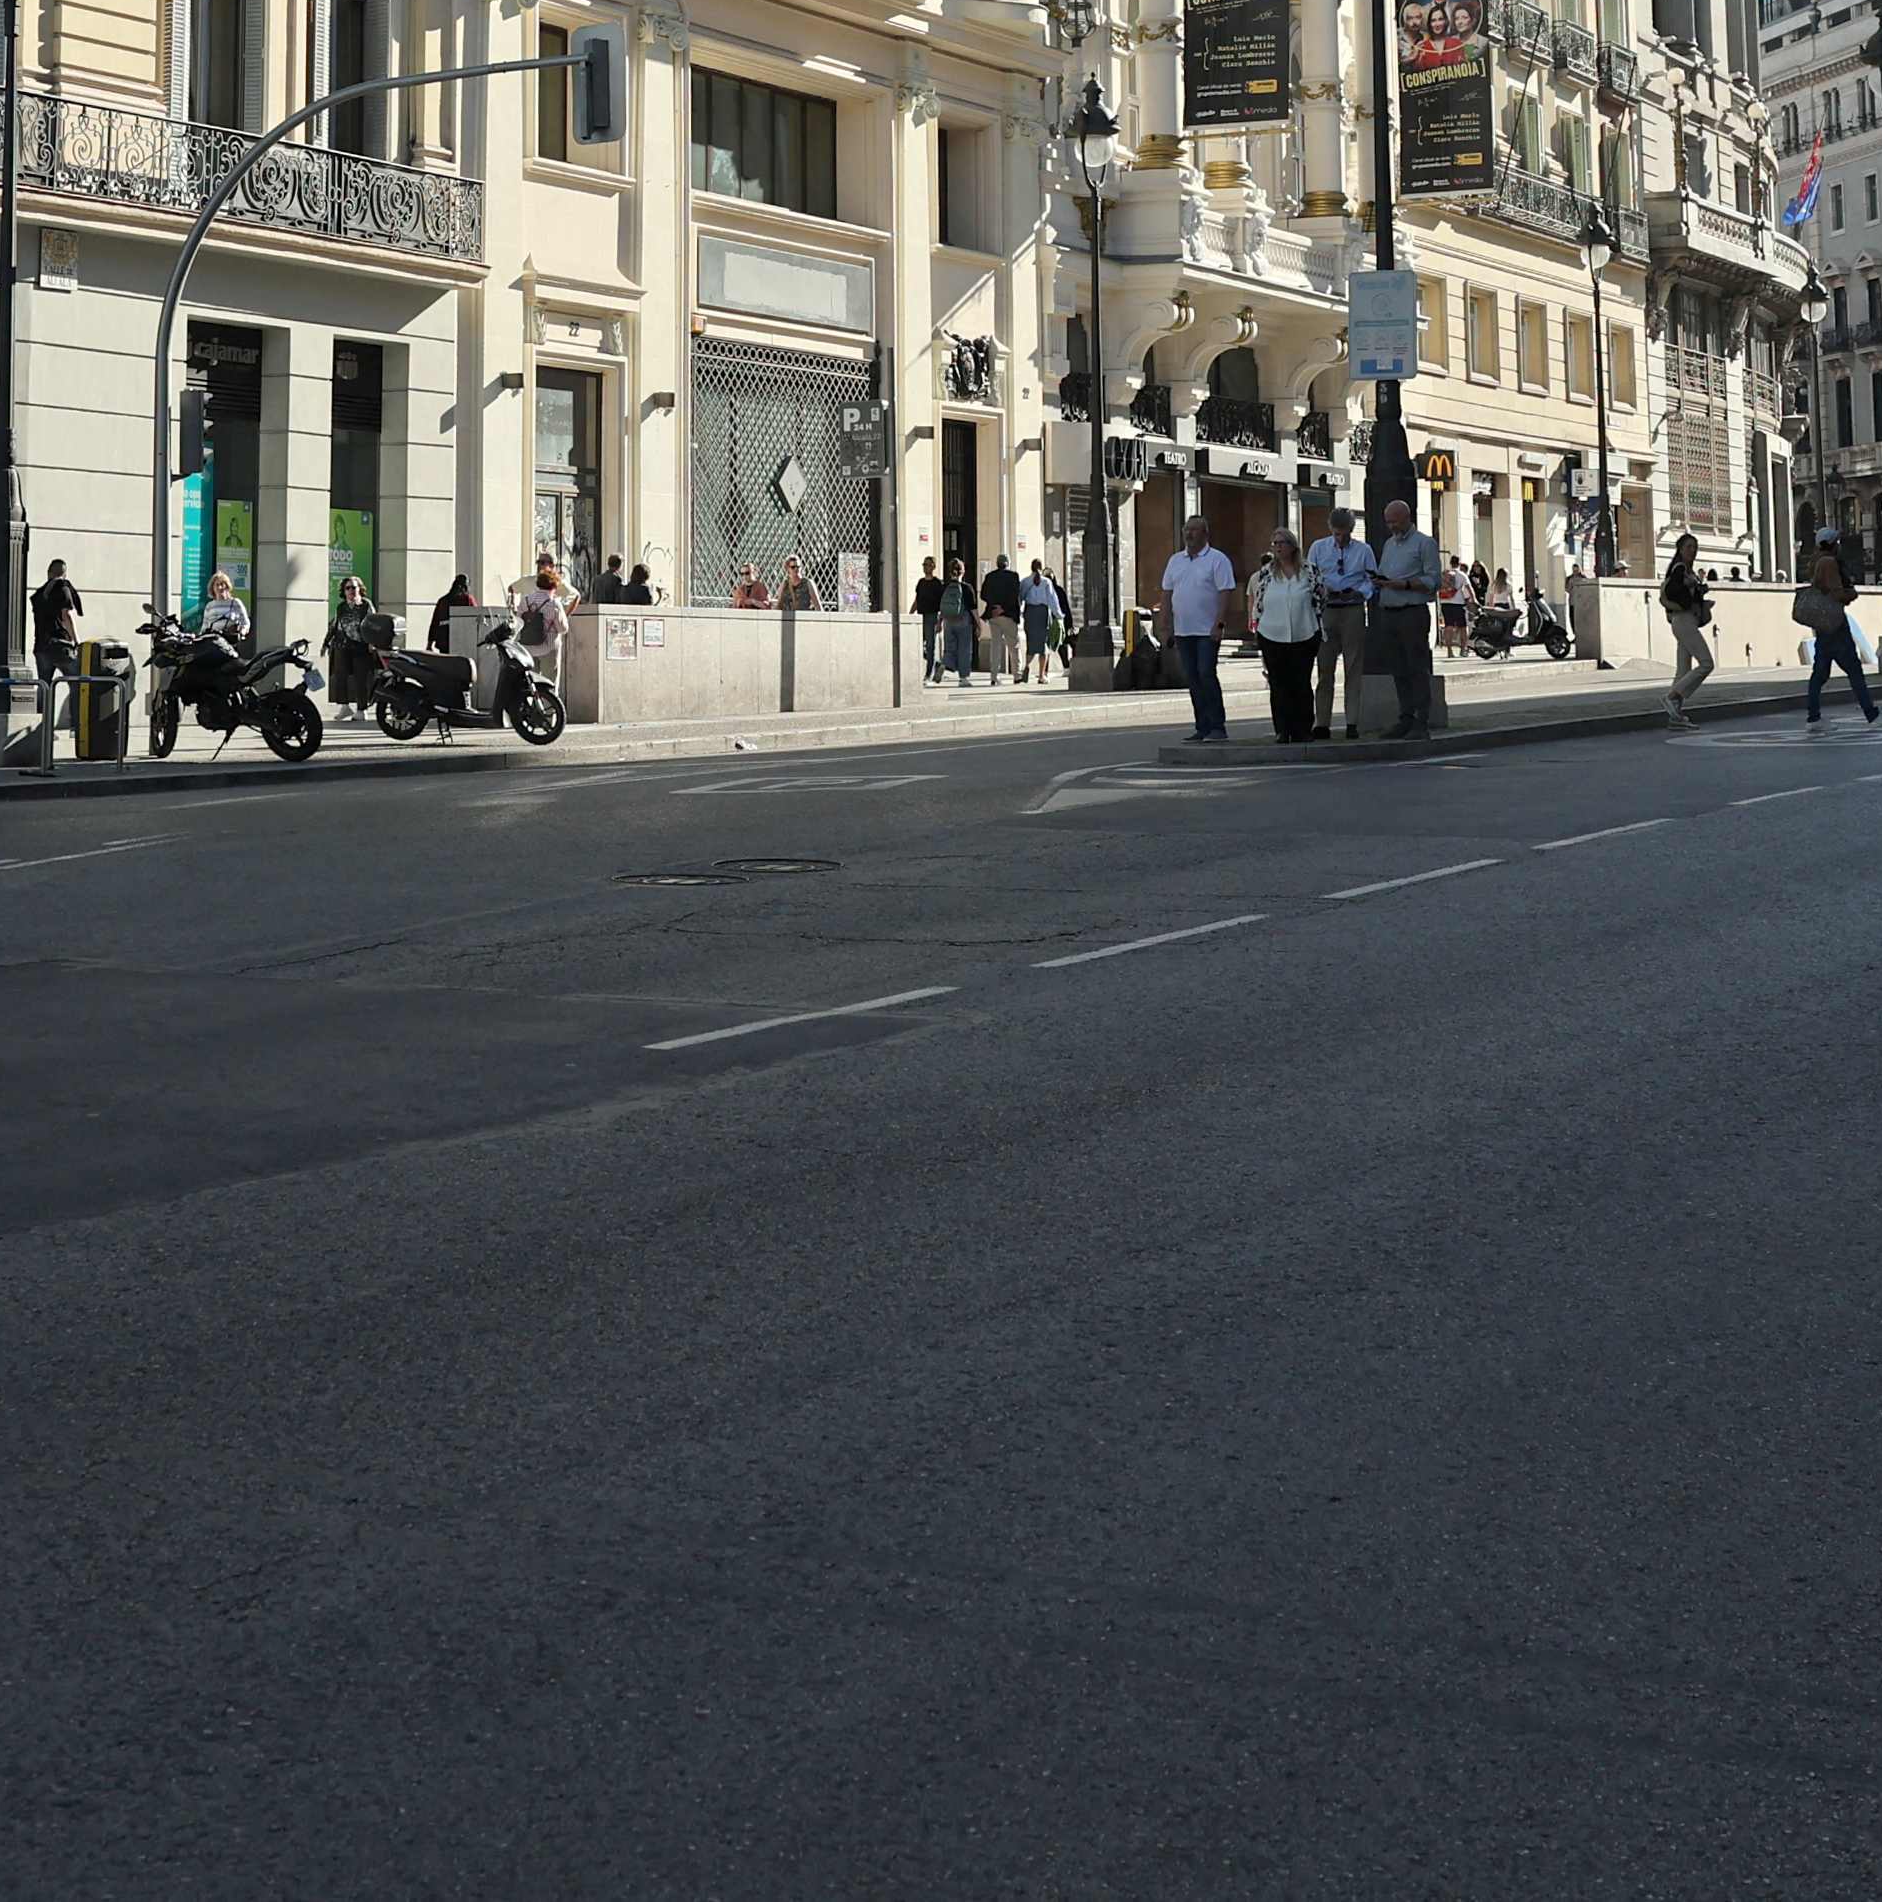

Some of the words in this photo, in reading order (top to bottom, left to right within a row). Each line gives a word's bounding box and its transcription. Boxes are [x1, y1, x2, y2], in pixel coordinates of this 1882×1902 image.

[569, 321, 581, 337] 22
[195, 337, 259, 367] cajamar
[843, 408, 861, 432] P
[853, 423, 864, 431] 24
[865, 423, 872, 431] H
[1164, 451, 1187, 466] TEATRO
[1326, 472, 1345, 486] TEATRO
